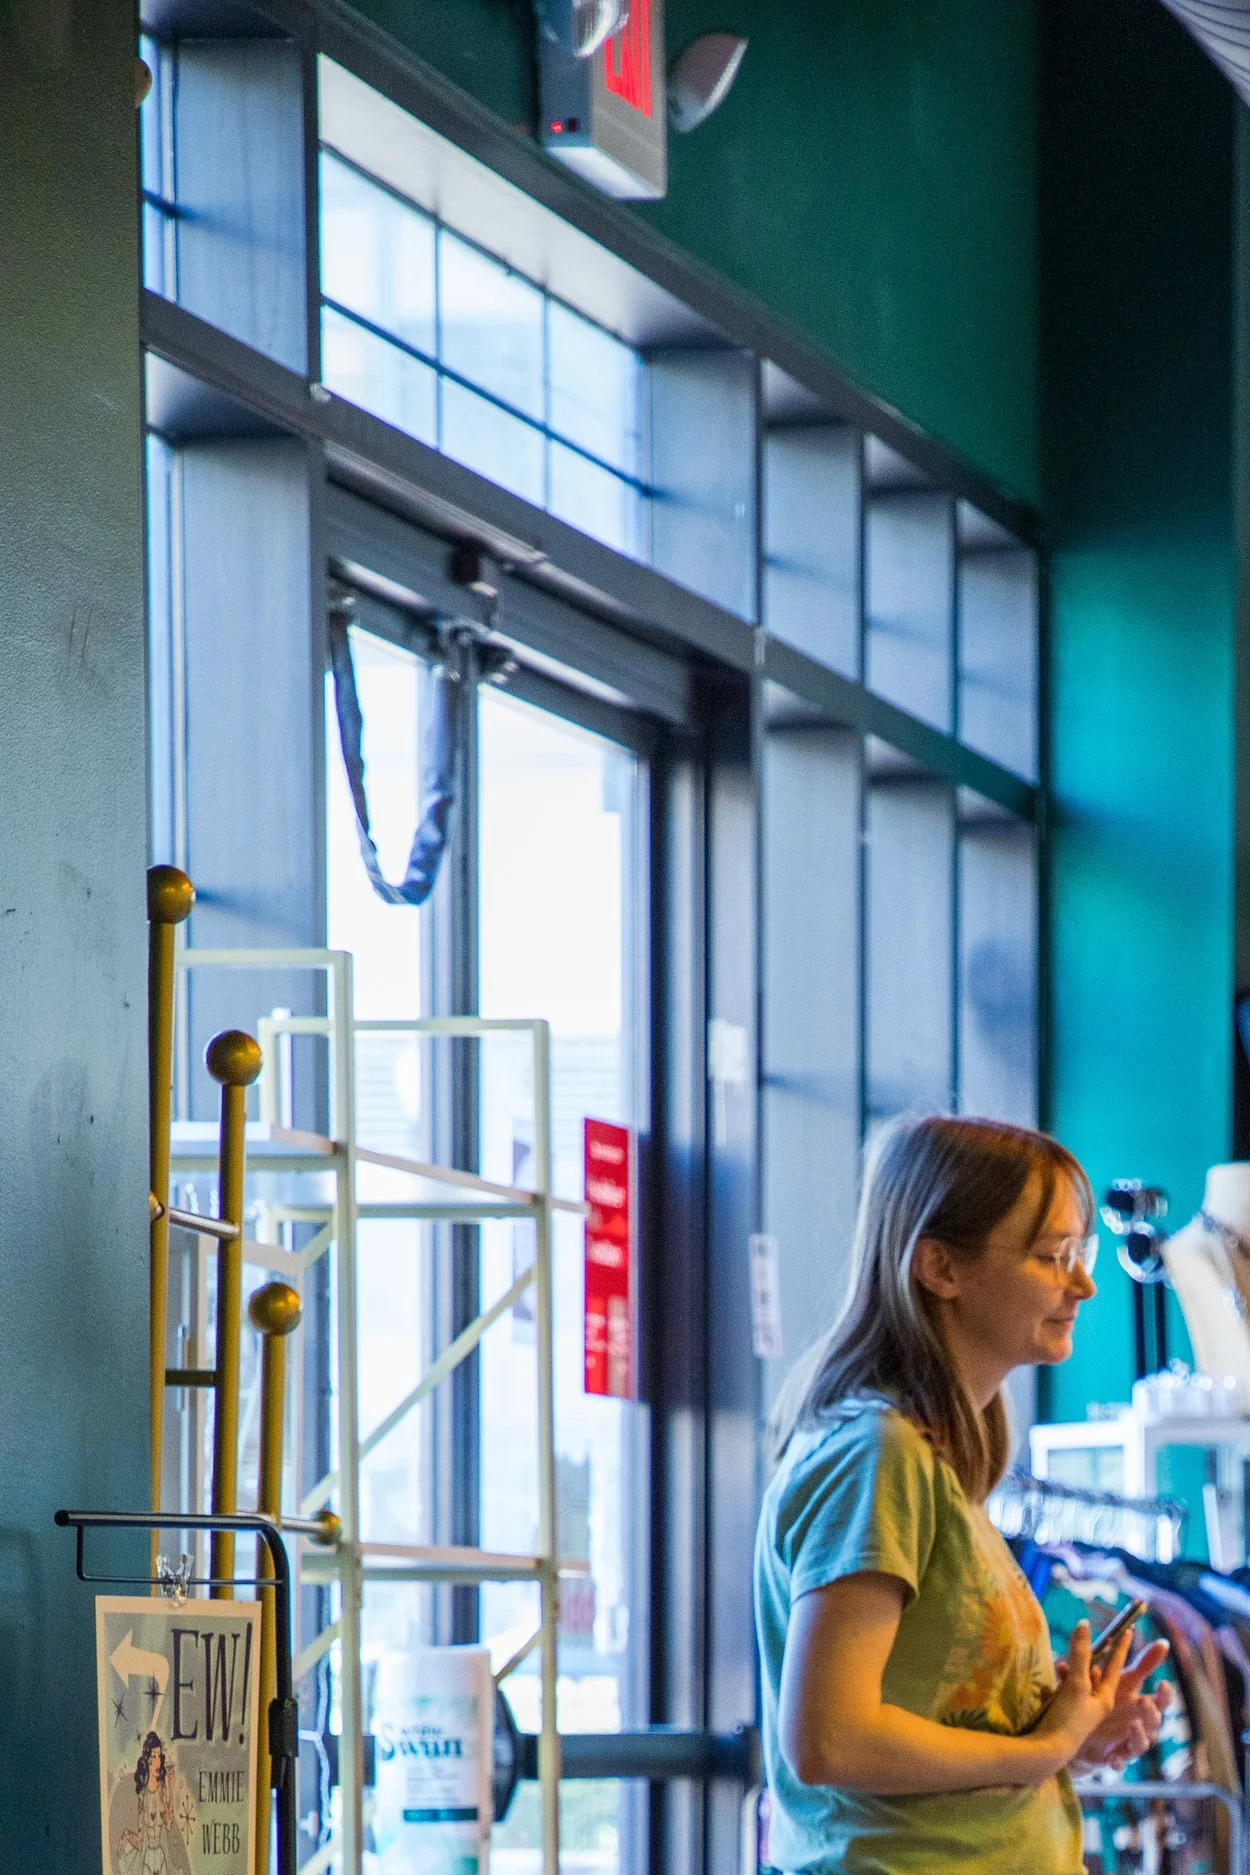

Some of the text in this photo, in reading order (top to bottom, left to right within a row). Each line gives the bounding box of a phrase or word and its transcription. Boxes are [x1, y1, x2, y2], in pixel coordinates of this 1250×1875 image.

[171, 1622, 253, 1745] EW!
[198, 1770, 245, 1803] EMMIE
[201, 1819, 241, 1855] WEBB
